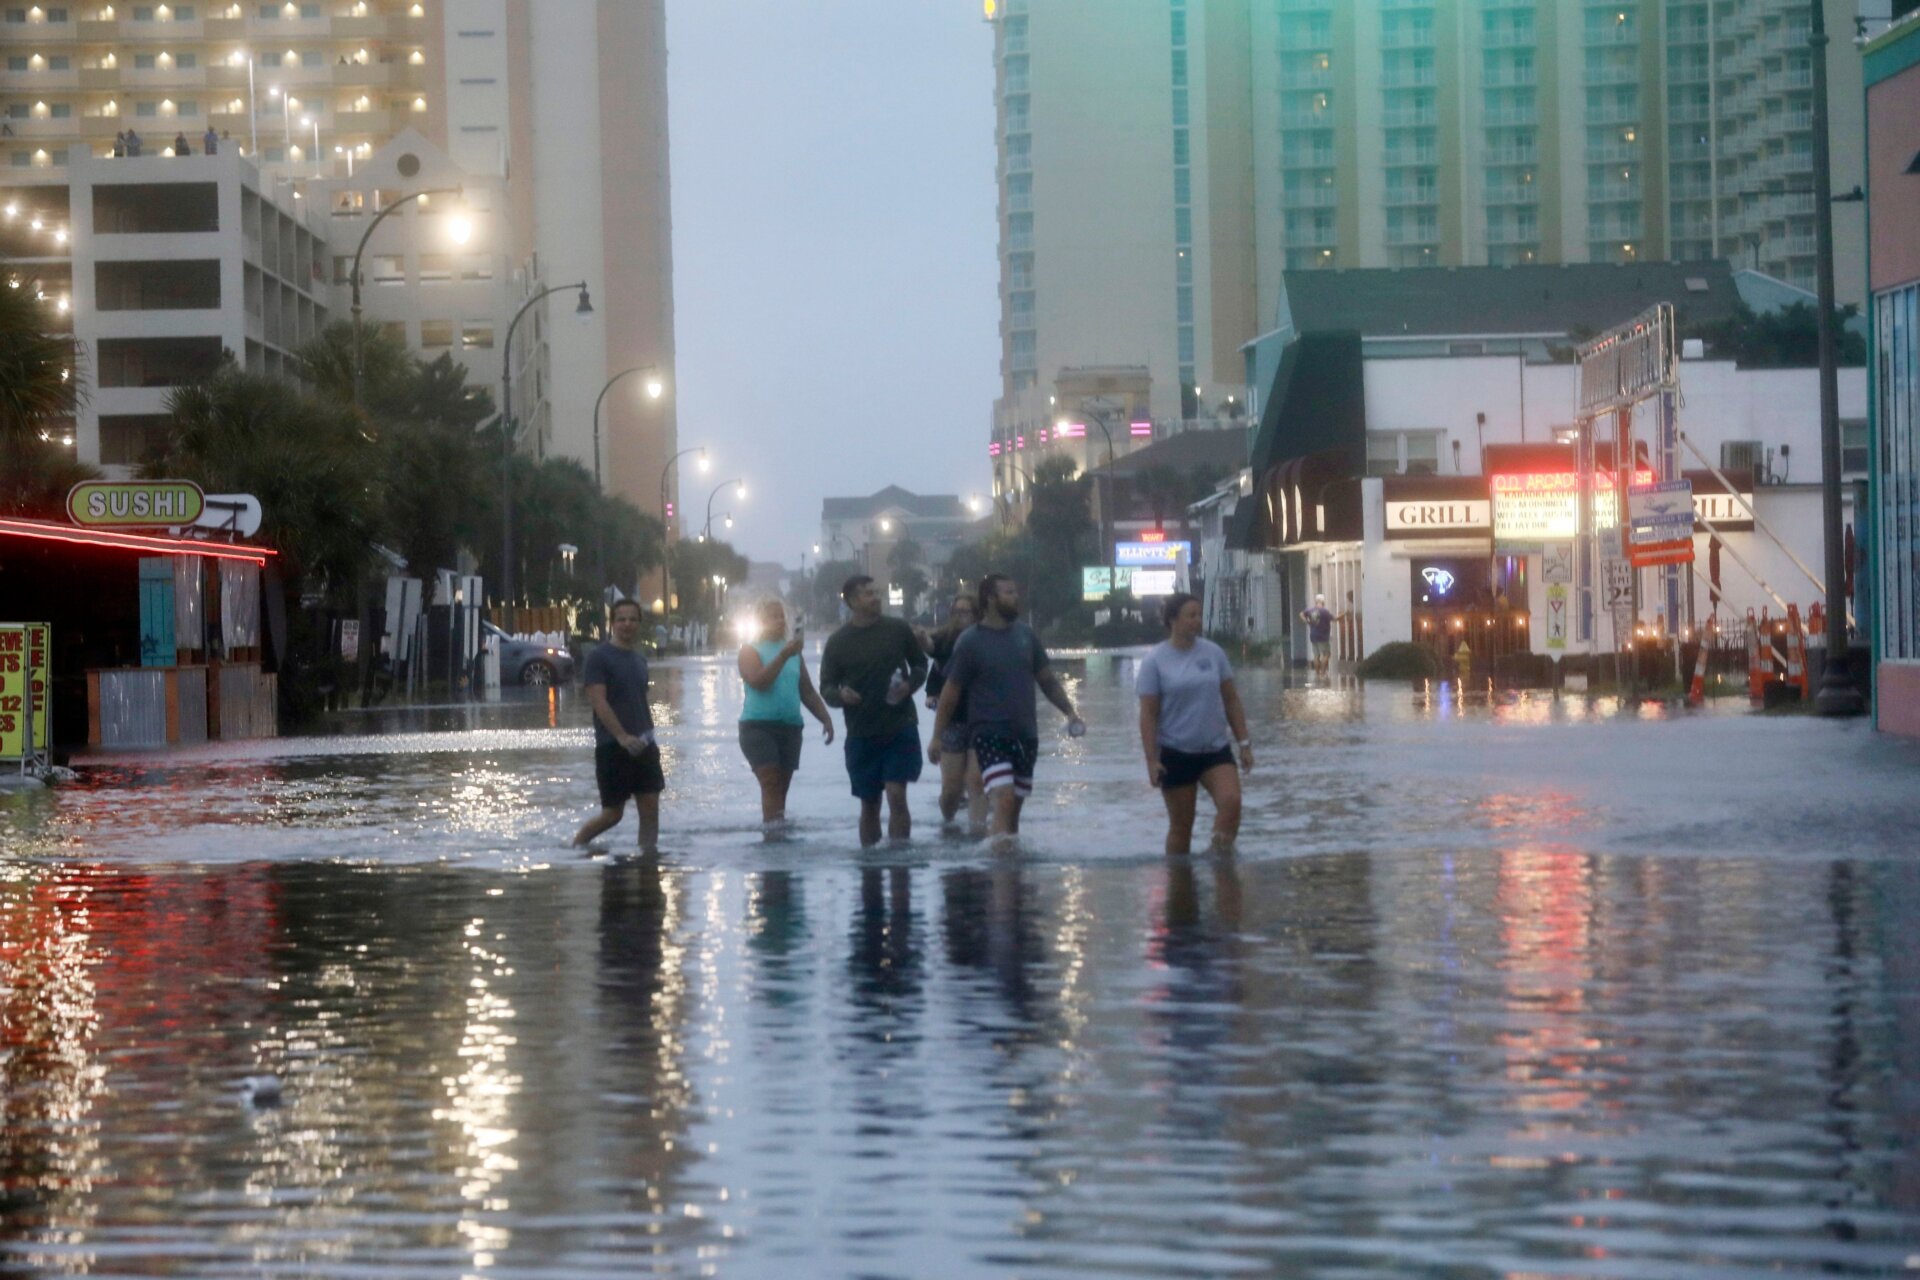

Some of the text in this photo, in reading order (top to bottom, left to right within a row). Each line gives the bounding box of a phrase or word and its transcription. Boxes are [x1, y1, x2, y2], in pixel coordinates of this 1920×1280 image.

[1526, 472, 1575, 489] ARCAD
[1550, 490, 1573, 498] EVER
[88, 491, 188, 518] SUSHI
[1399, 505, 1480, 524] GRILL
[1608, 586, 1632, 606] 25
